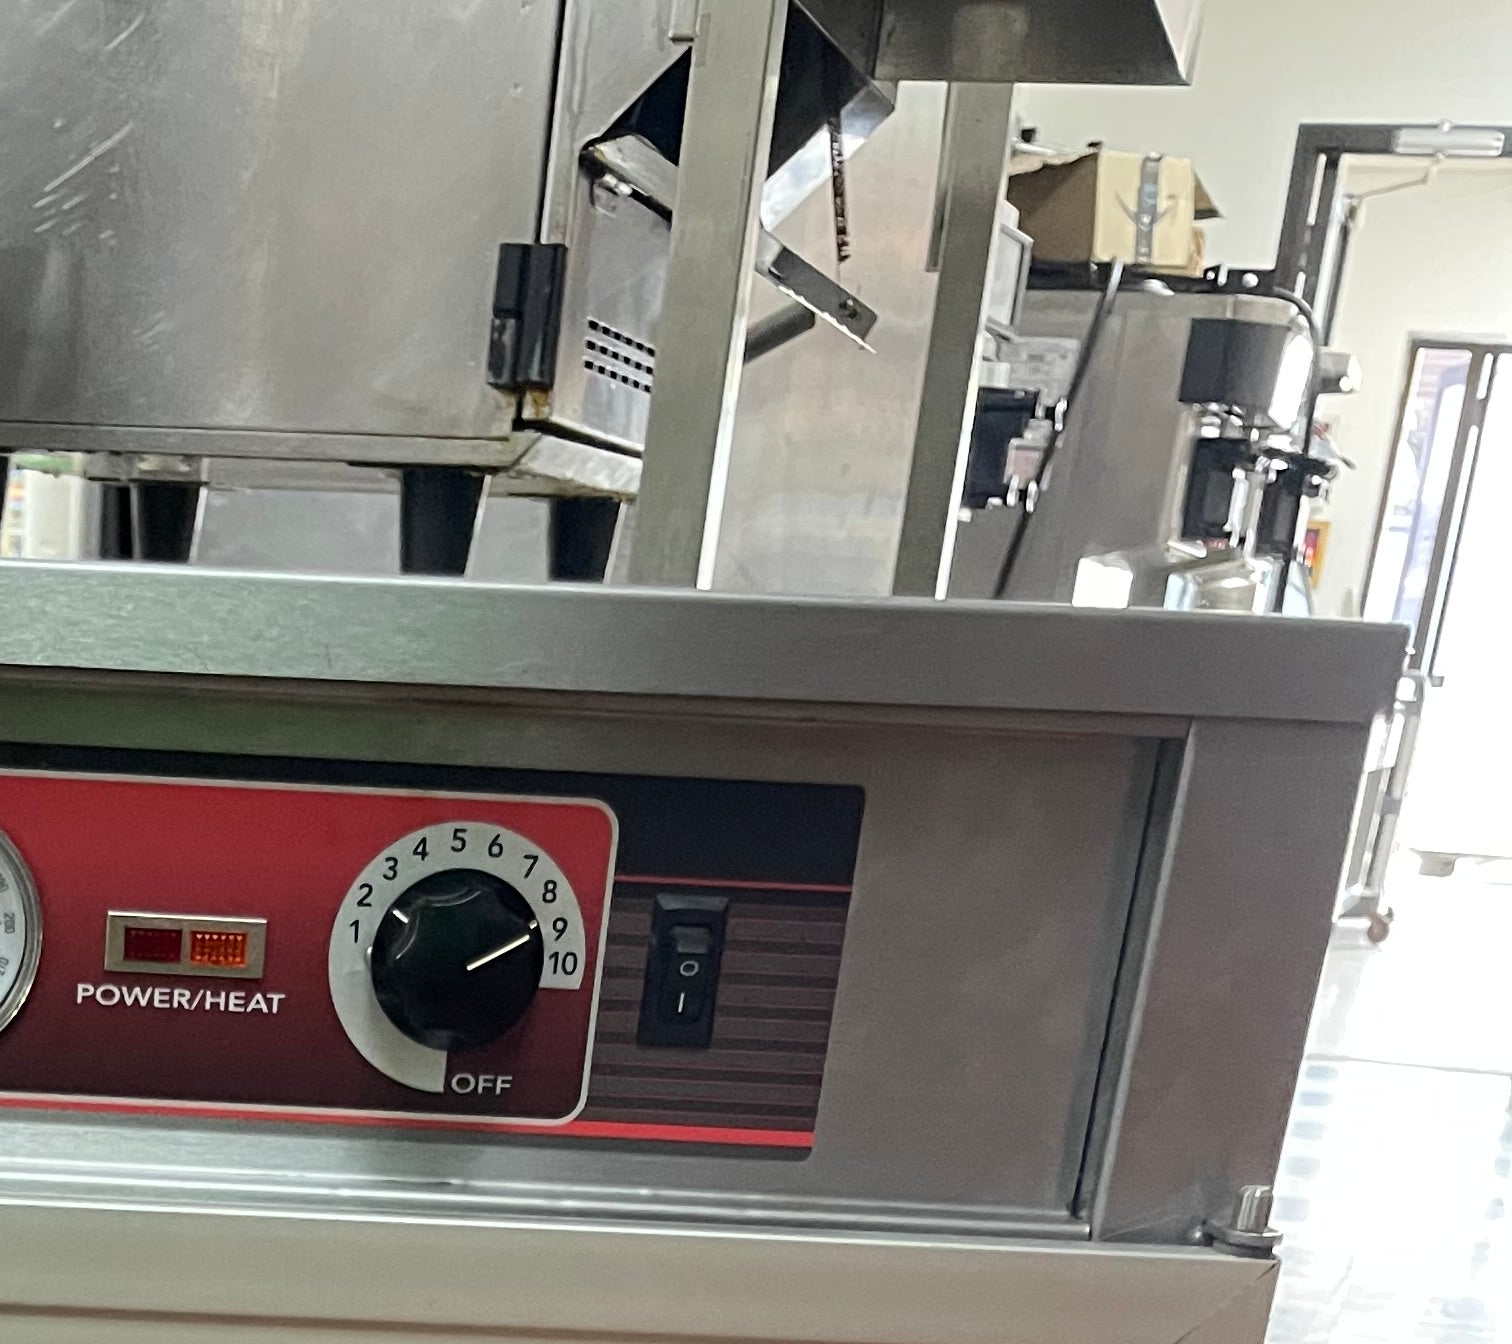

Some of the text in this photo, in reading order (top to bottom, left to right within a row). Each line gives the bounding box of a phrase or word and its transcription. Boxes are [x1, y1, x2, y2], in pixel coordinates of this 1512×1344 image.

[349, 828, 578, 975] 1 2 3 4 5 6 7 8 9 10
[76, 983, 286, 1014] POWER/HEAT
[451, 1073, 513, 1095] OFF
